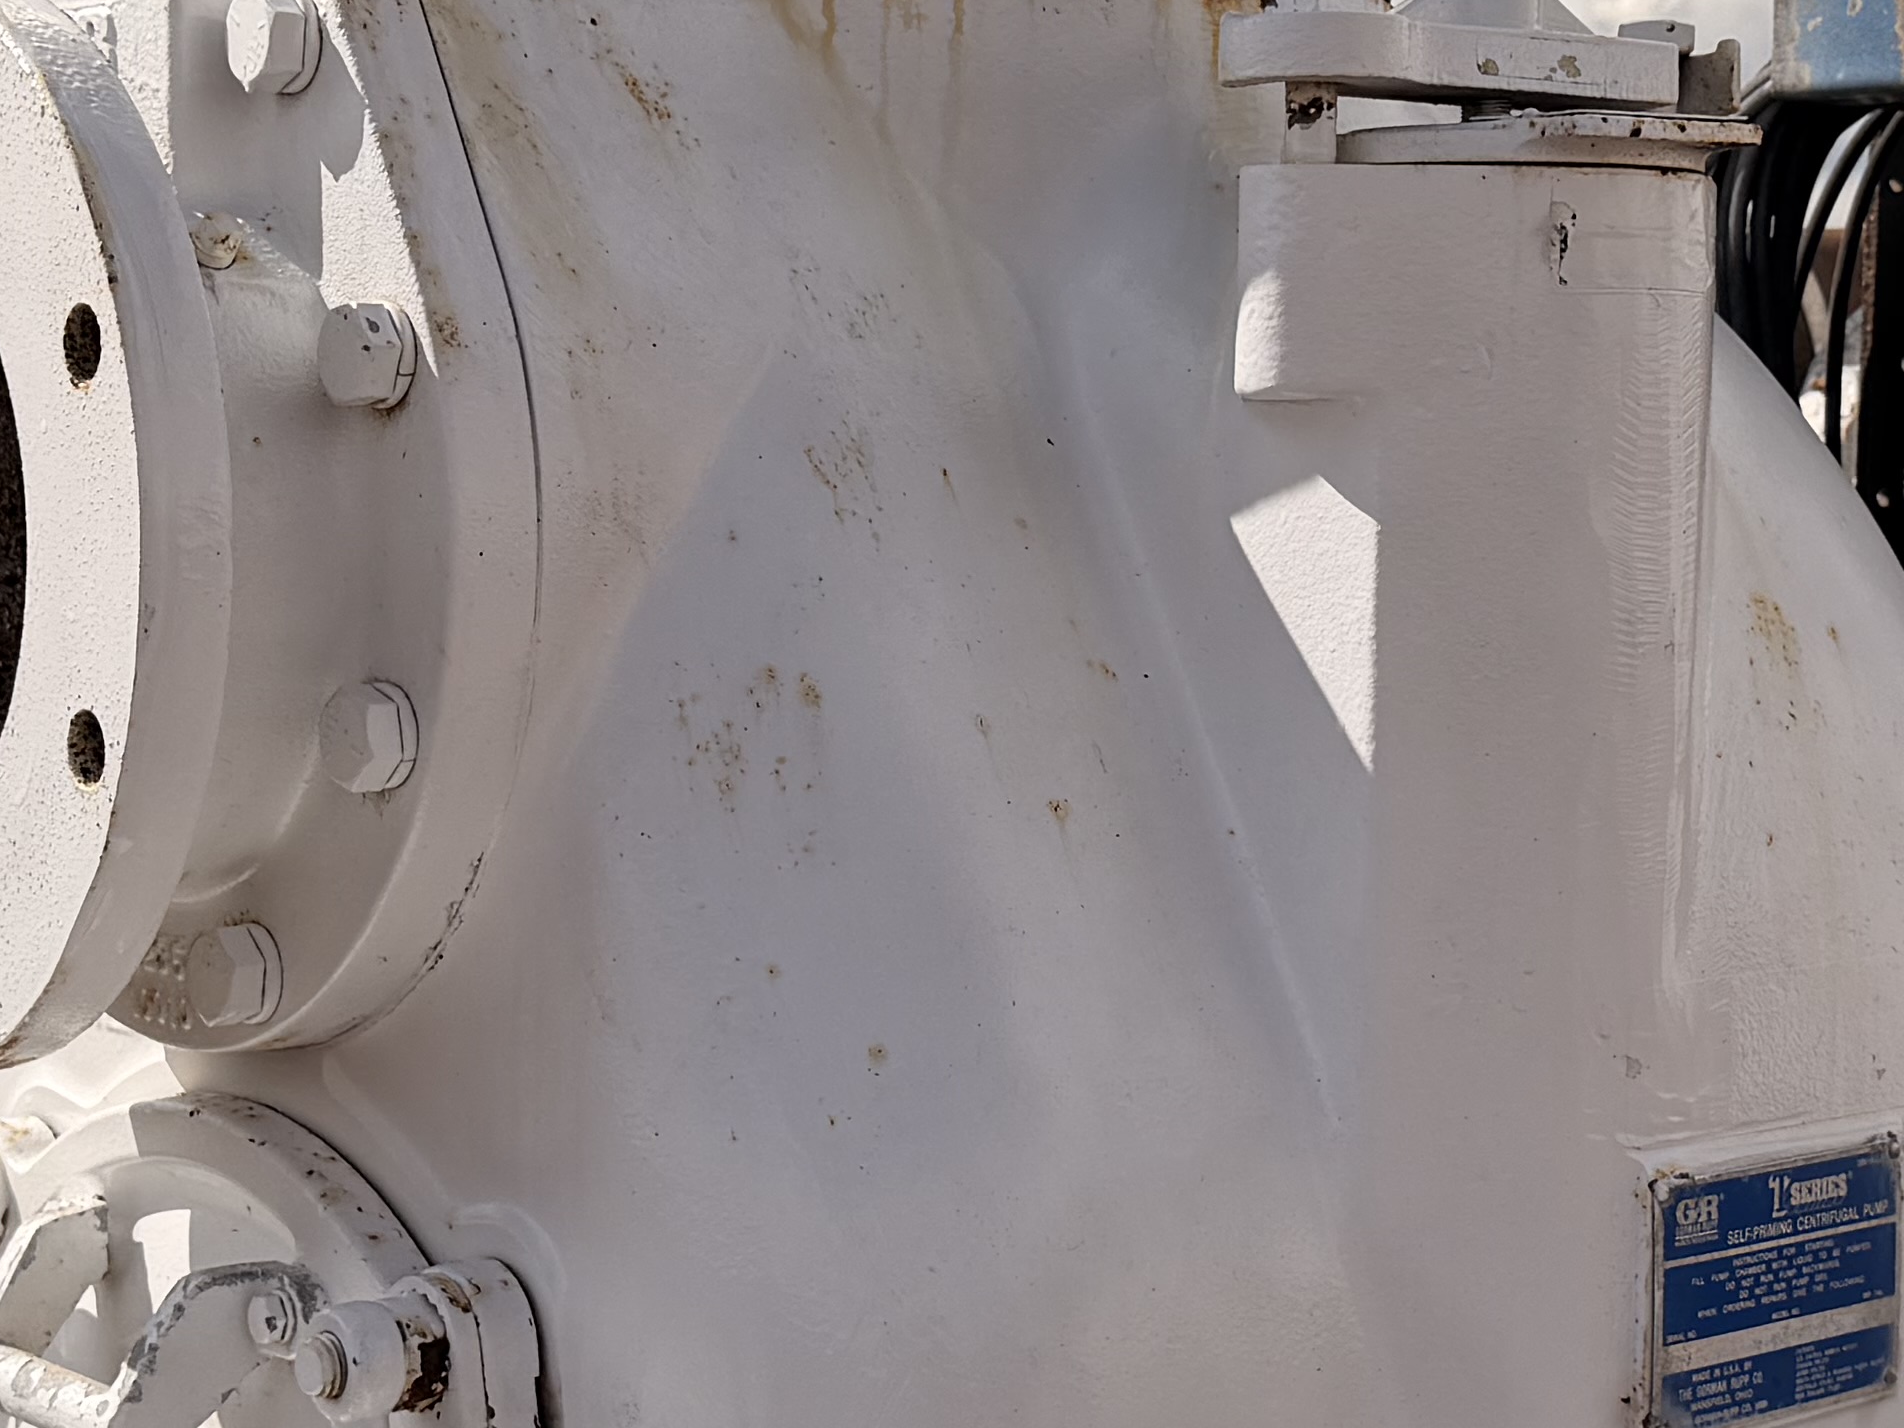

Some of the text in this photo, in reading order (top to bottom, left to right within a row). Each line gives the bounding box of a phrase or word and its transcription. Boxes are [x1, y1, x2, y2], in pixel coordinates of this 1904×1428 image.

[1790, 1172, 1848, 1206] SERIES
[1727, 1218, 1793, 1245] SELF-PRIMING
[1797, 1206, 1860, 1231] CENTRIFUGAL
[1863, 1198, 1889, 1217] PUMP
